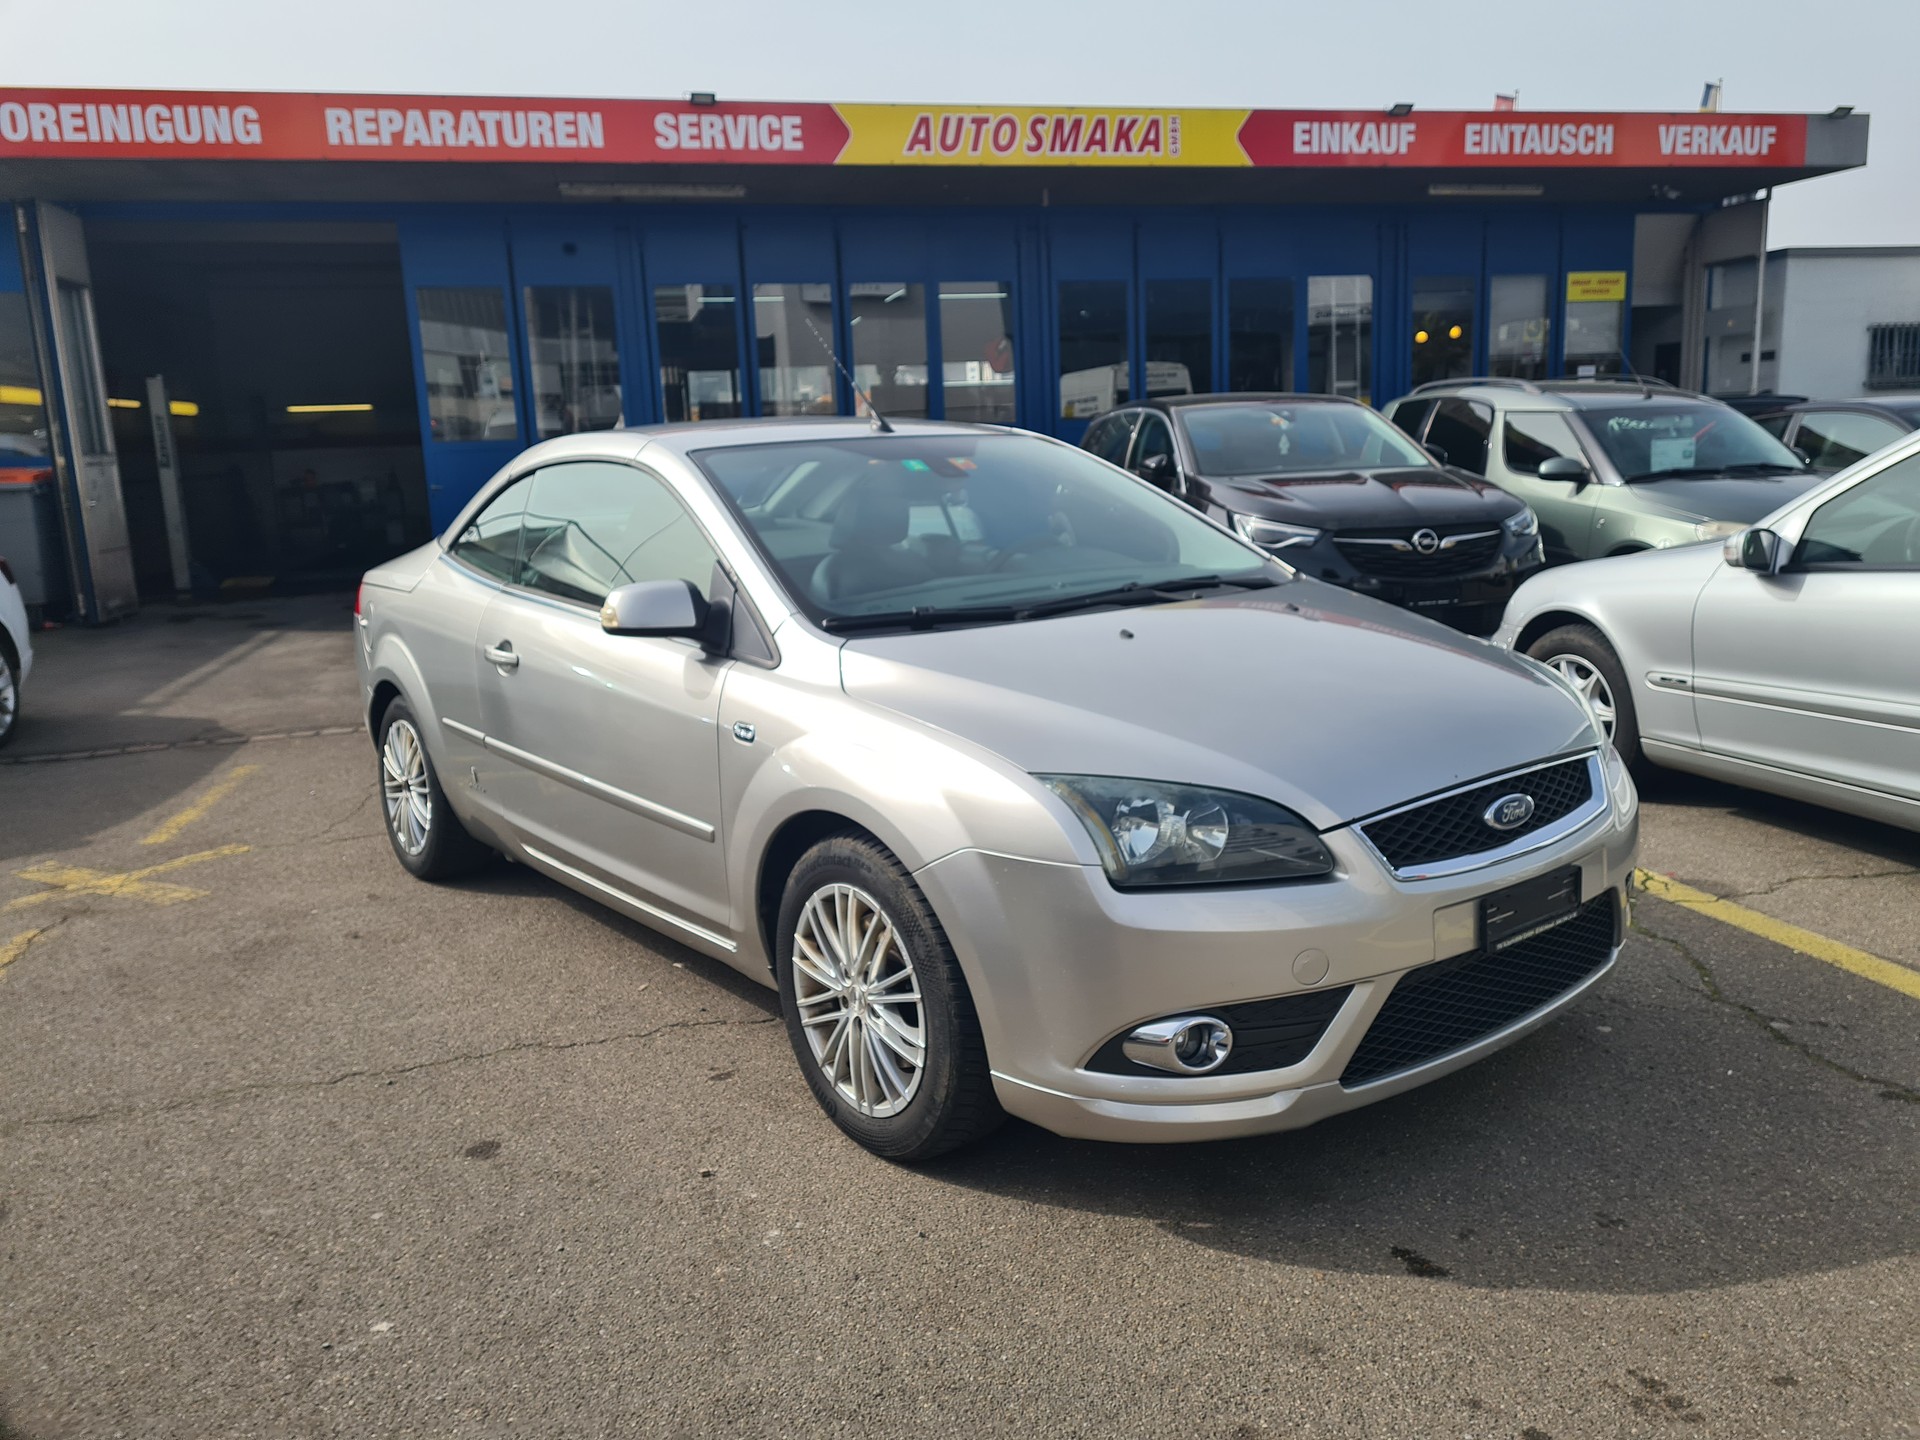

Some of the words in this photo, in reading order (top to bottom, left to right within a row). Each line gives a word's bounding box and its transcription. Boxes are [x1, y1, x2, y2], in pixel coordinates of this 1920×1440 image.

[0, 102, 263, 145] OREINIGUNG
[325, 107, 605, 149] REPARATUREN
[653, 112, 804, 152] SERVICE
[906, 116, 1017, 152] AUTO
[1026, 116, 1161, 153] SMAKA
[1293, 121, 1417, 156] EINKAUF
[1464, 122, 1614, 156] EINTAUSCH
[1658, 124, 1777, 157] VERKAUF
[1501, 800, 1526, 823] Ford
